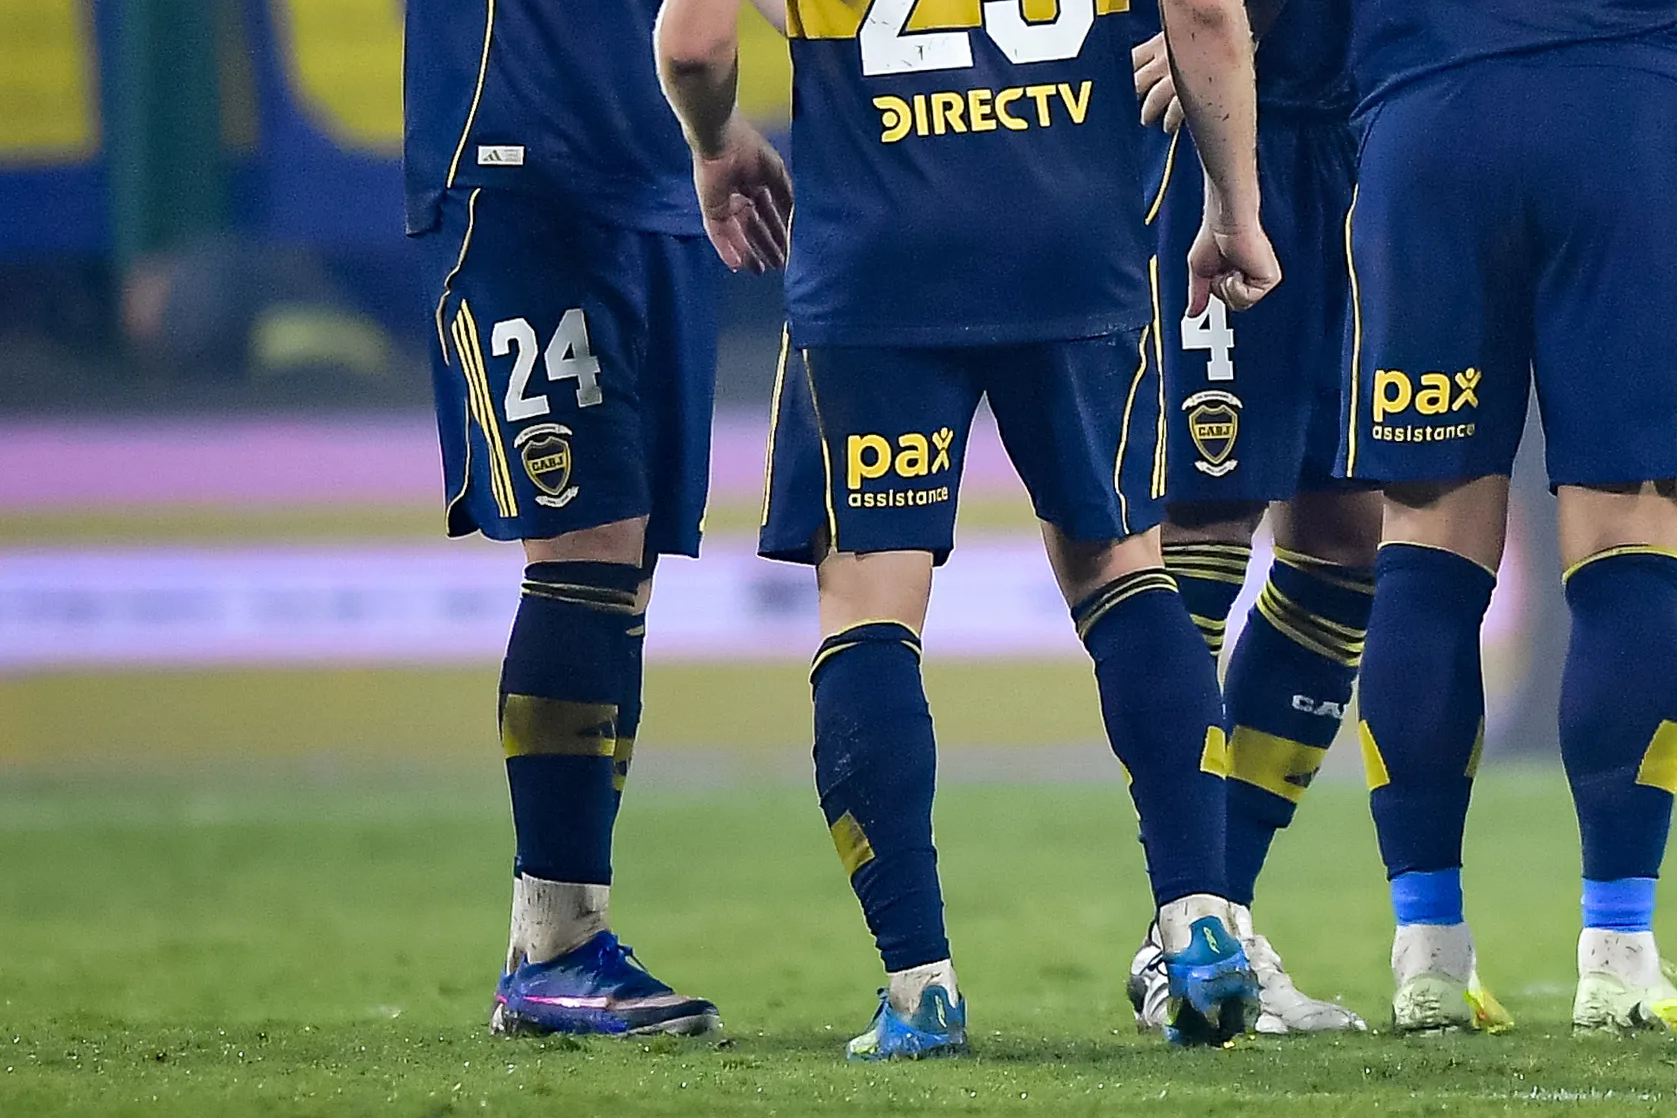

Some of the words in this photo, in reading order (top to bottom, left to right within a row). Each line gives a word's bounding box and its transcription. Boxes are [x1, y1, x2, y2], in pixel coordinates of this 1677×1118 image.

[872, 81, 1092, 142] DIRECTV
[491, 308, 603, 421] 24
[1373, 367, 1481, 422] pax
[847, 427, 953, 490] pax
[1372, 424, 1475, 442] assistance
[847, 487, 949, 507] assistance
